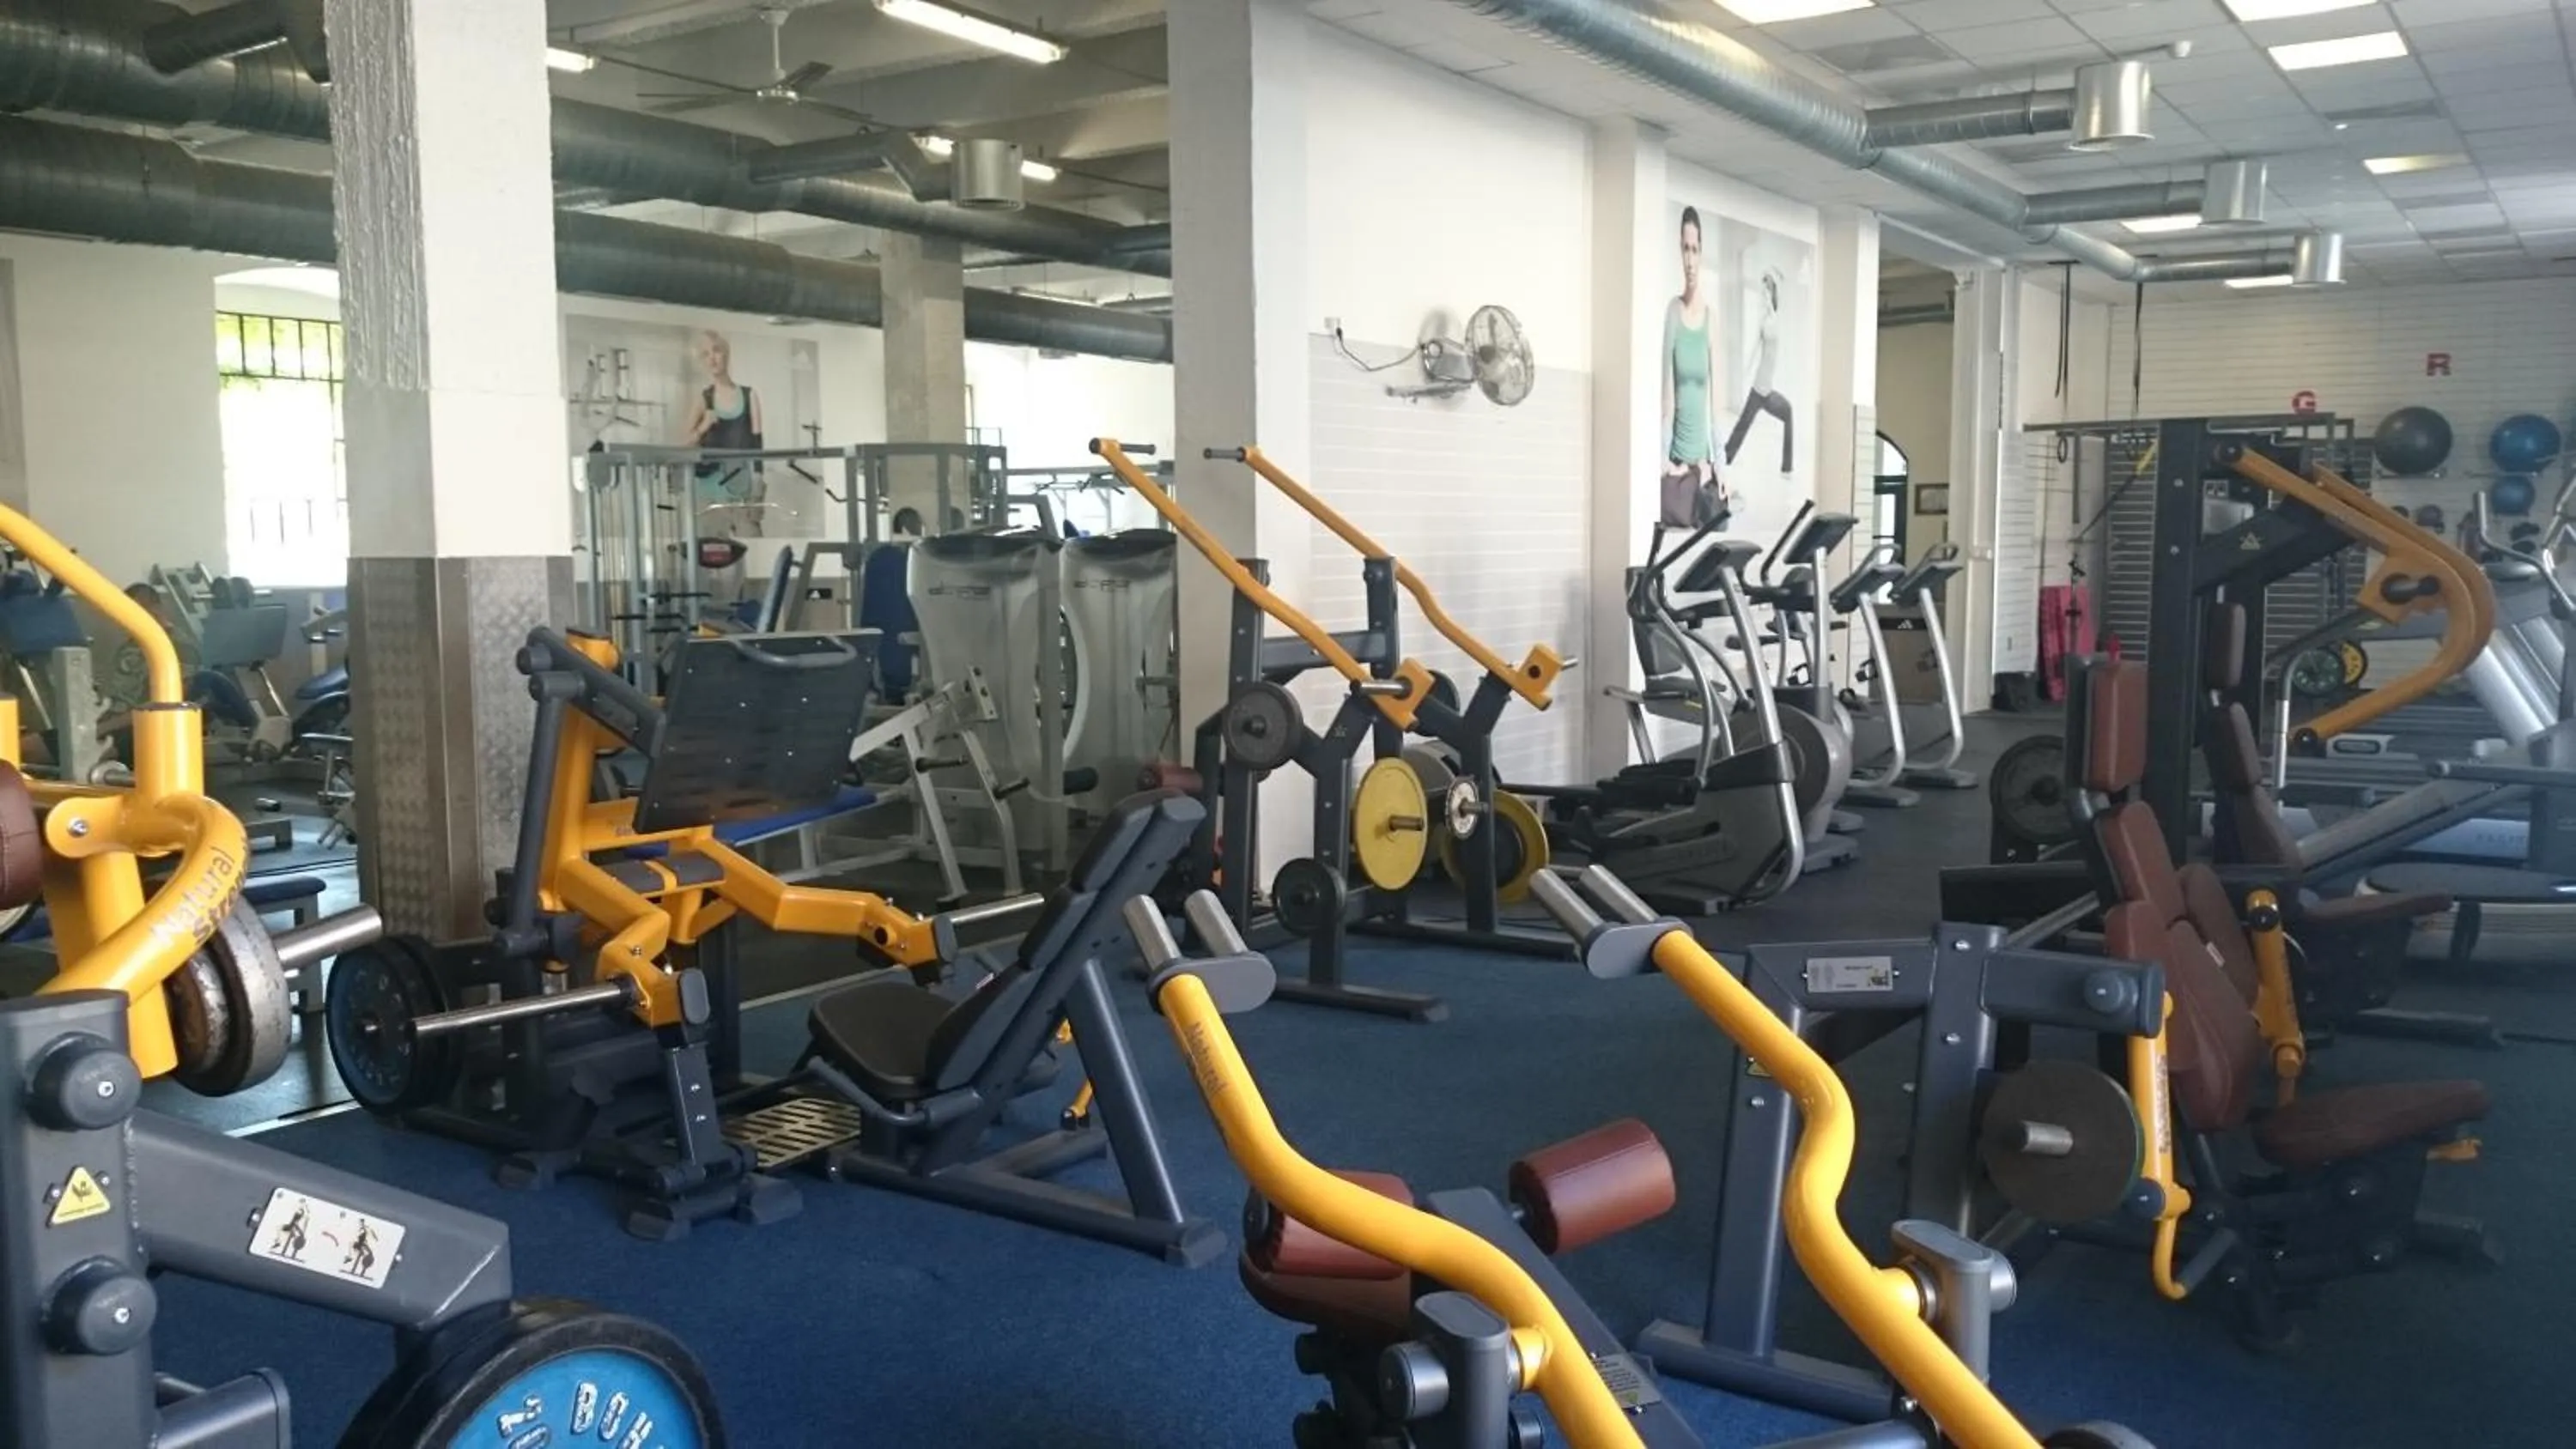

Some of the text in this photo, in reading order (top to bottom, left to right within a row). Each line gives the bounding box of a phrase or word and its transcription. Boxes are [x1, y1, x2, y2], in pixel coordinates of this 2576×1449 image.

[2426, 353, 2451, 376] R
[2292, 391, 2317, 414] G
[150, 846, 236, 943] Natural
